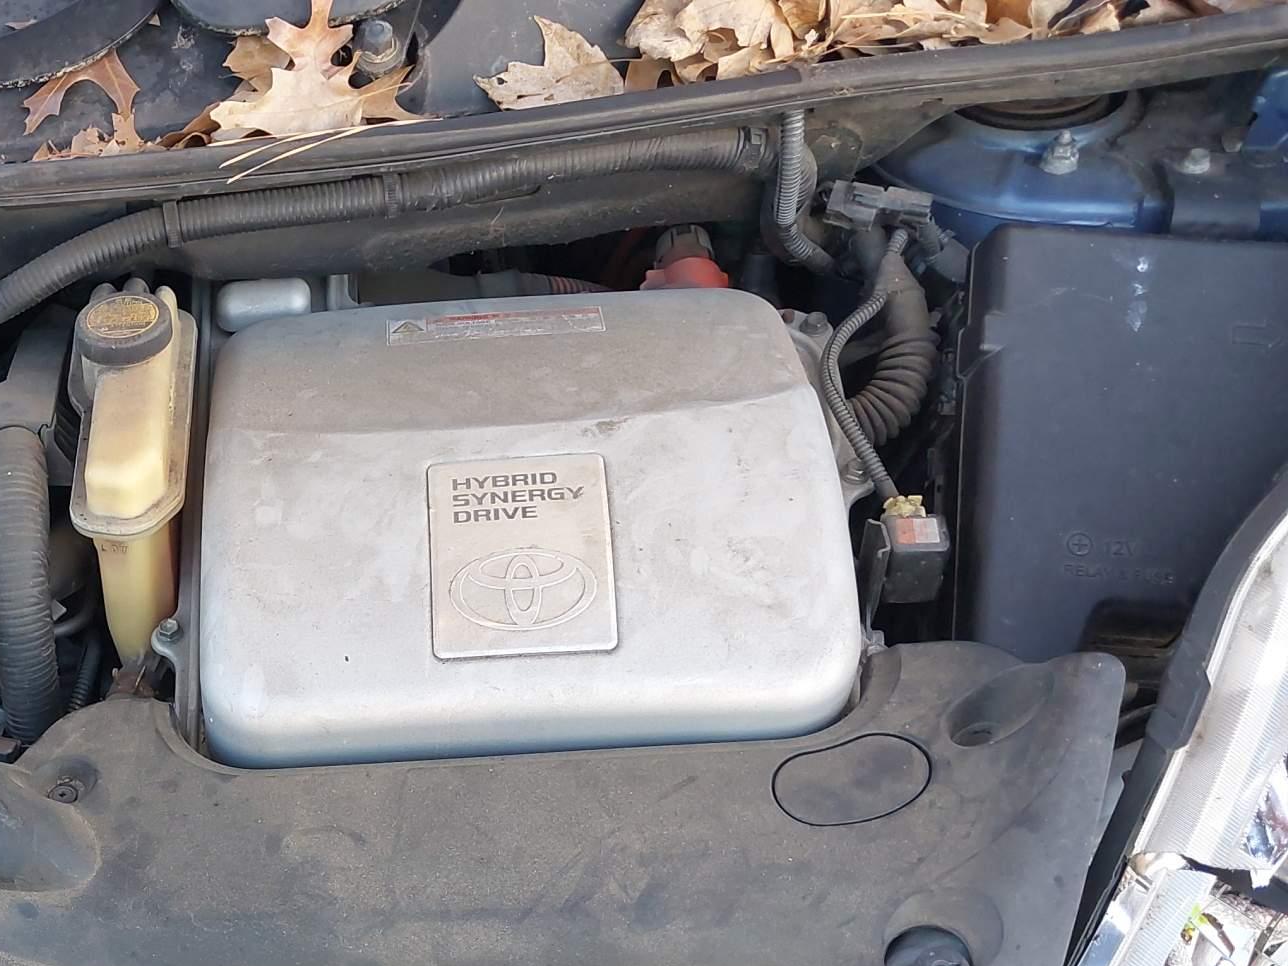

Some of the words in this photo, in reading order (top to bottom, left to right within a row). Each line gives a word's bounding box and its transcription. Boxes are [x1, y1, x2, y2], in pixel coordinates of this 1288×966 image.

[452, 472, 557, 491] HYBRID
[453, 486, 584, 507] SYNERGY
[453, 506, 538, 524] DRIVE
